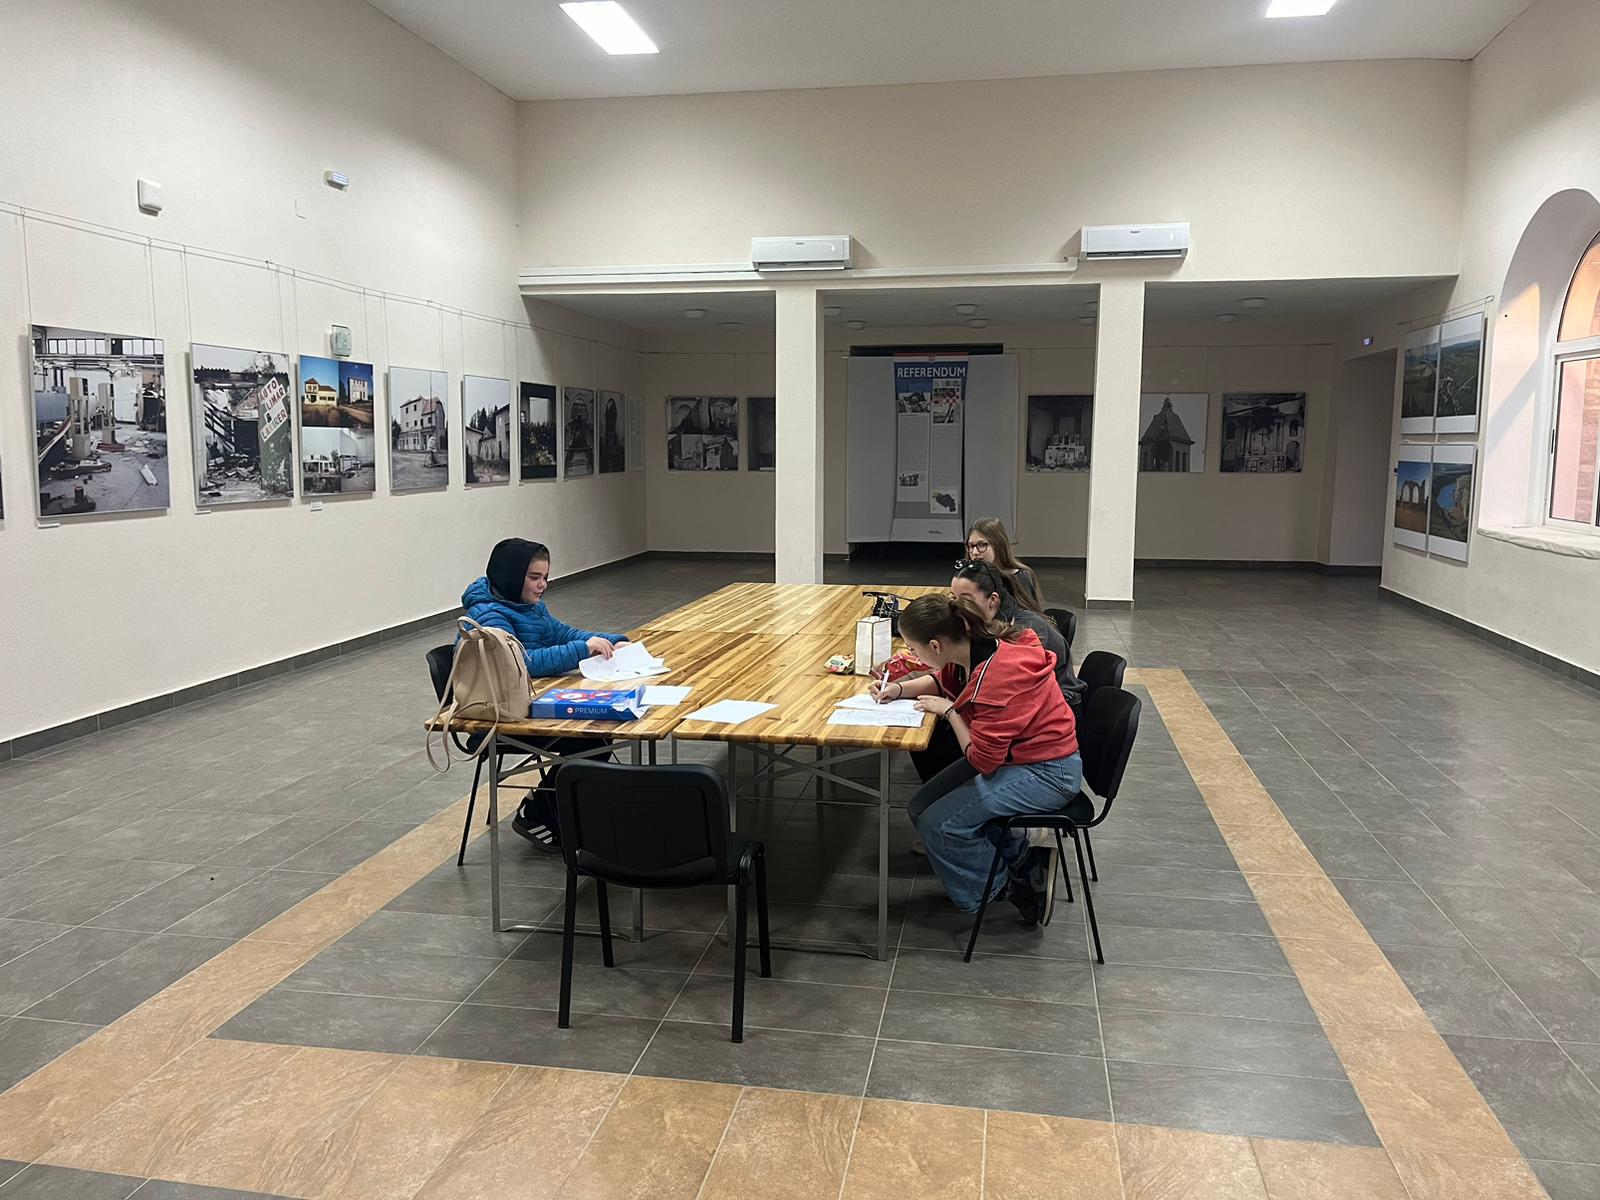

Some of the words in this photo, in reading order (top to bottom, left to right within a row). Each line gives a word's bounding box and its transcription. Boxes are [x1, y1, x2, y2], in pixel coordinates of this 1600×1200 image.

[897, 367, 966, 378] REFERENDUM
[260, 380, 277, 402] AUTO
[265, 387, 285, 411] LIMAR
[574, 707, 608, 715] PREMIUM
